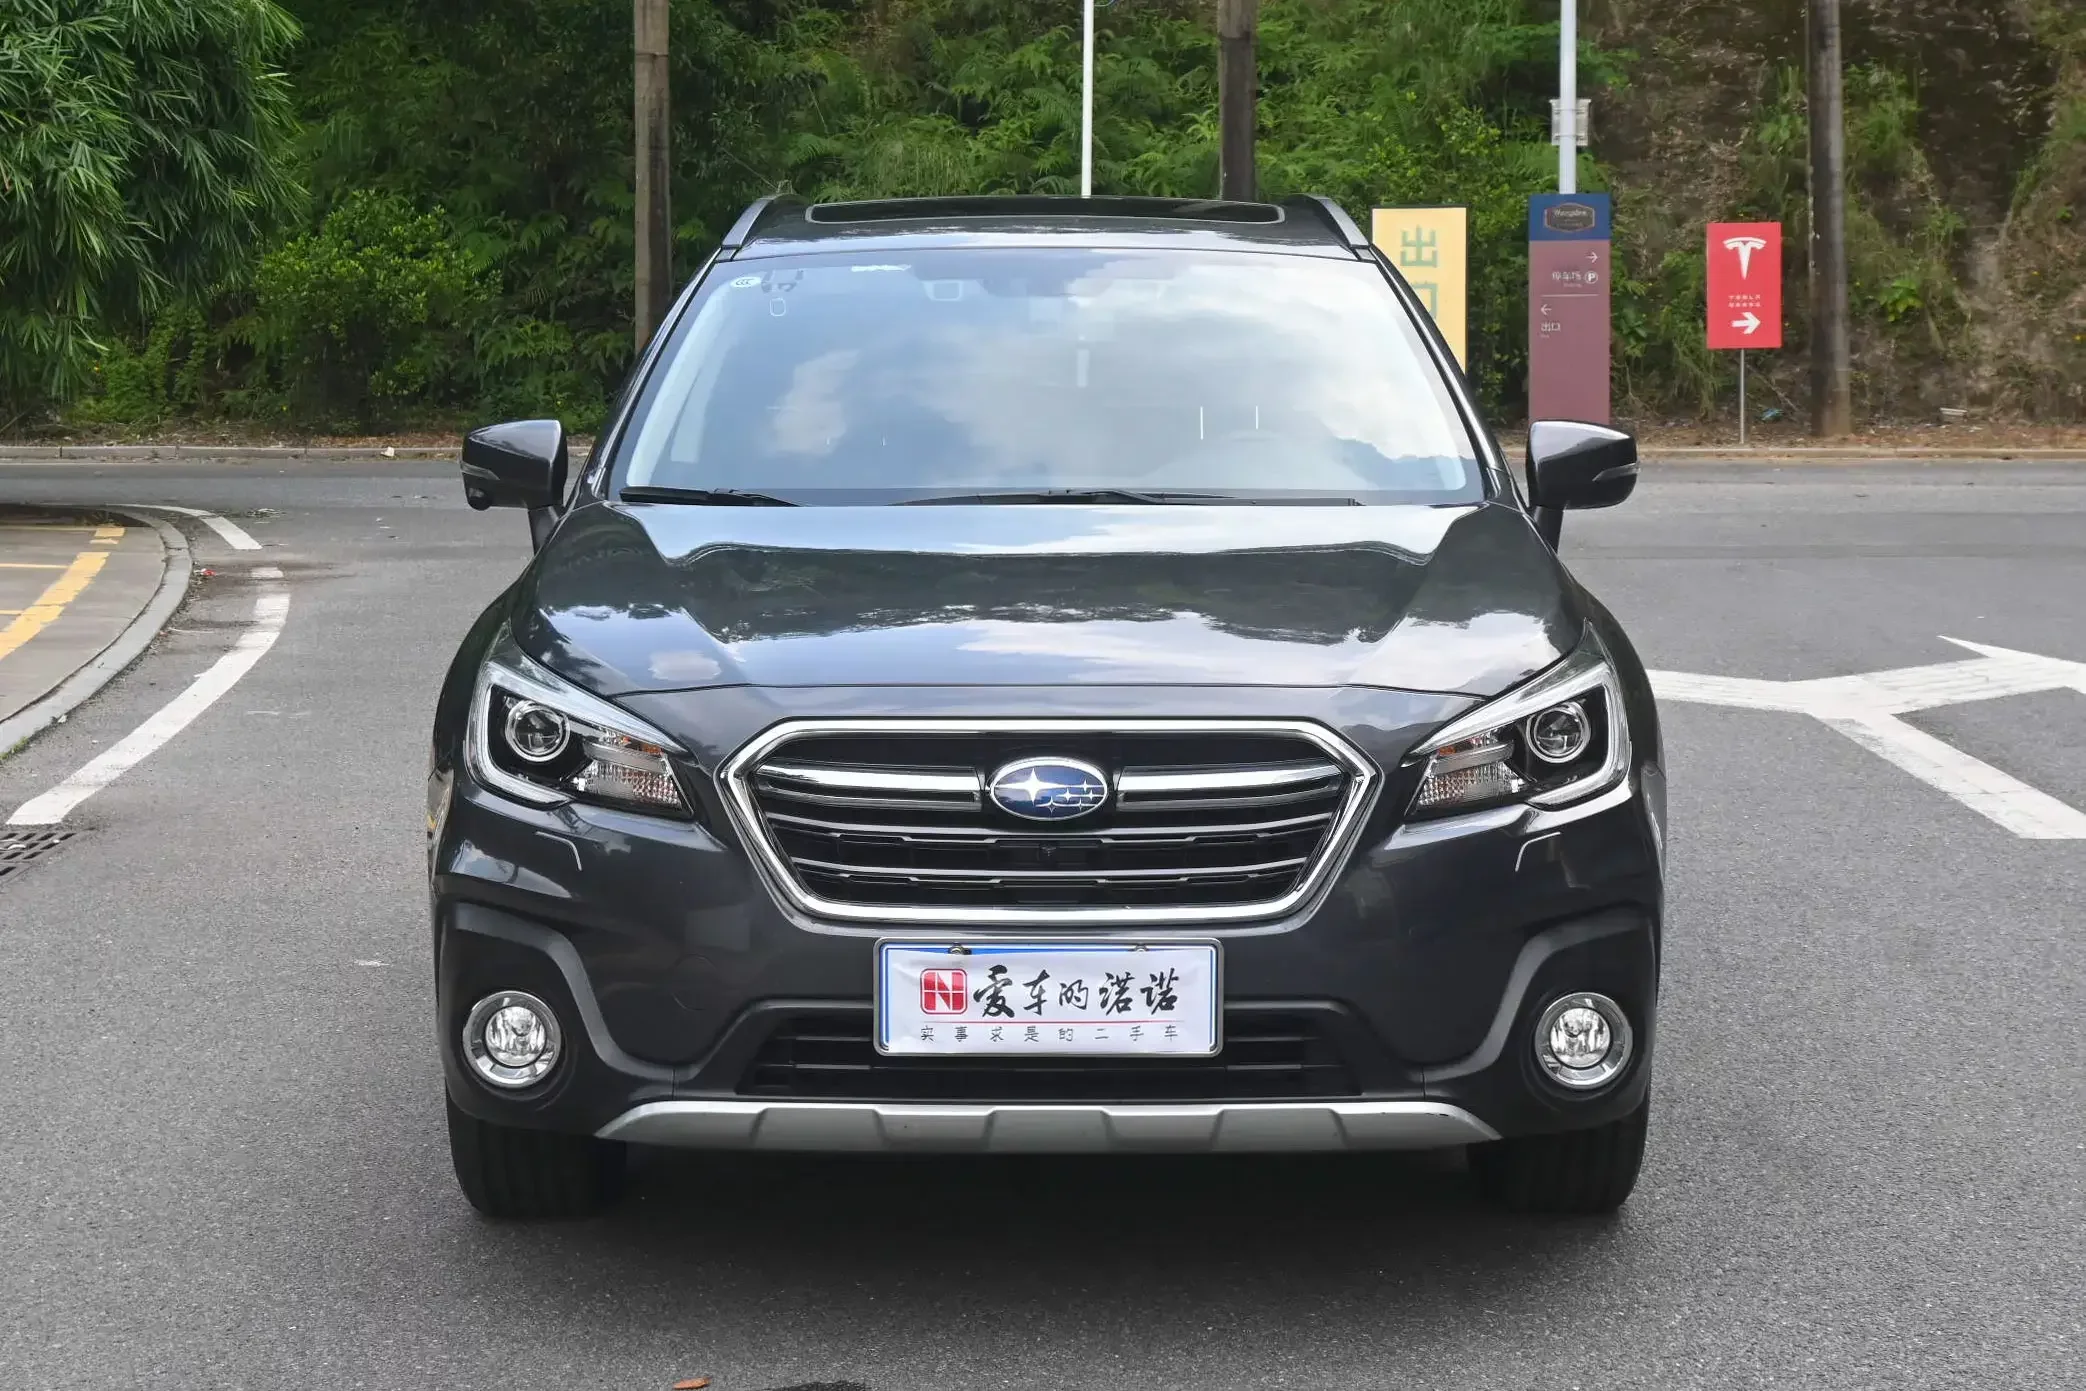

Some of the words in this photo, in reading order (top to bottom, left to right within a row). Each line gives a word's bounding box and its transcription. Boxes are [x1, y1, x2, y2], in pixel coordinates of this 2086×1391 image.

[920, 1025, 1179, 1042] 实事求是的二手车
